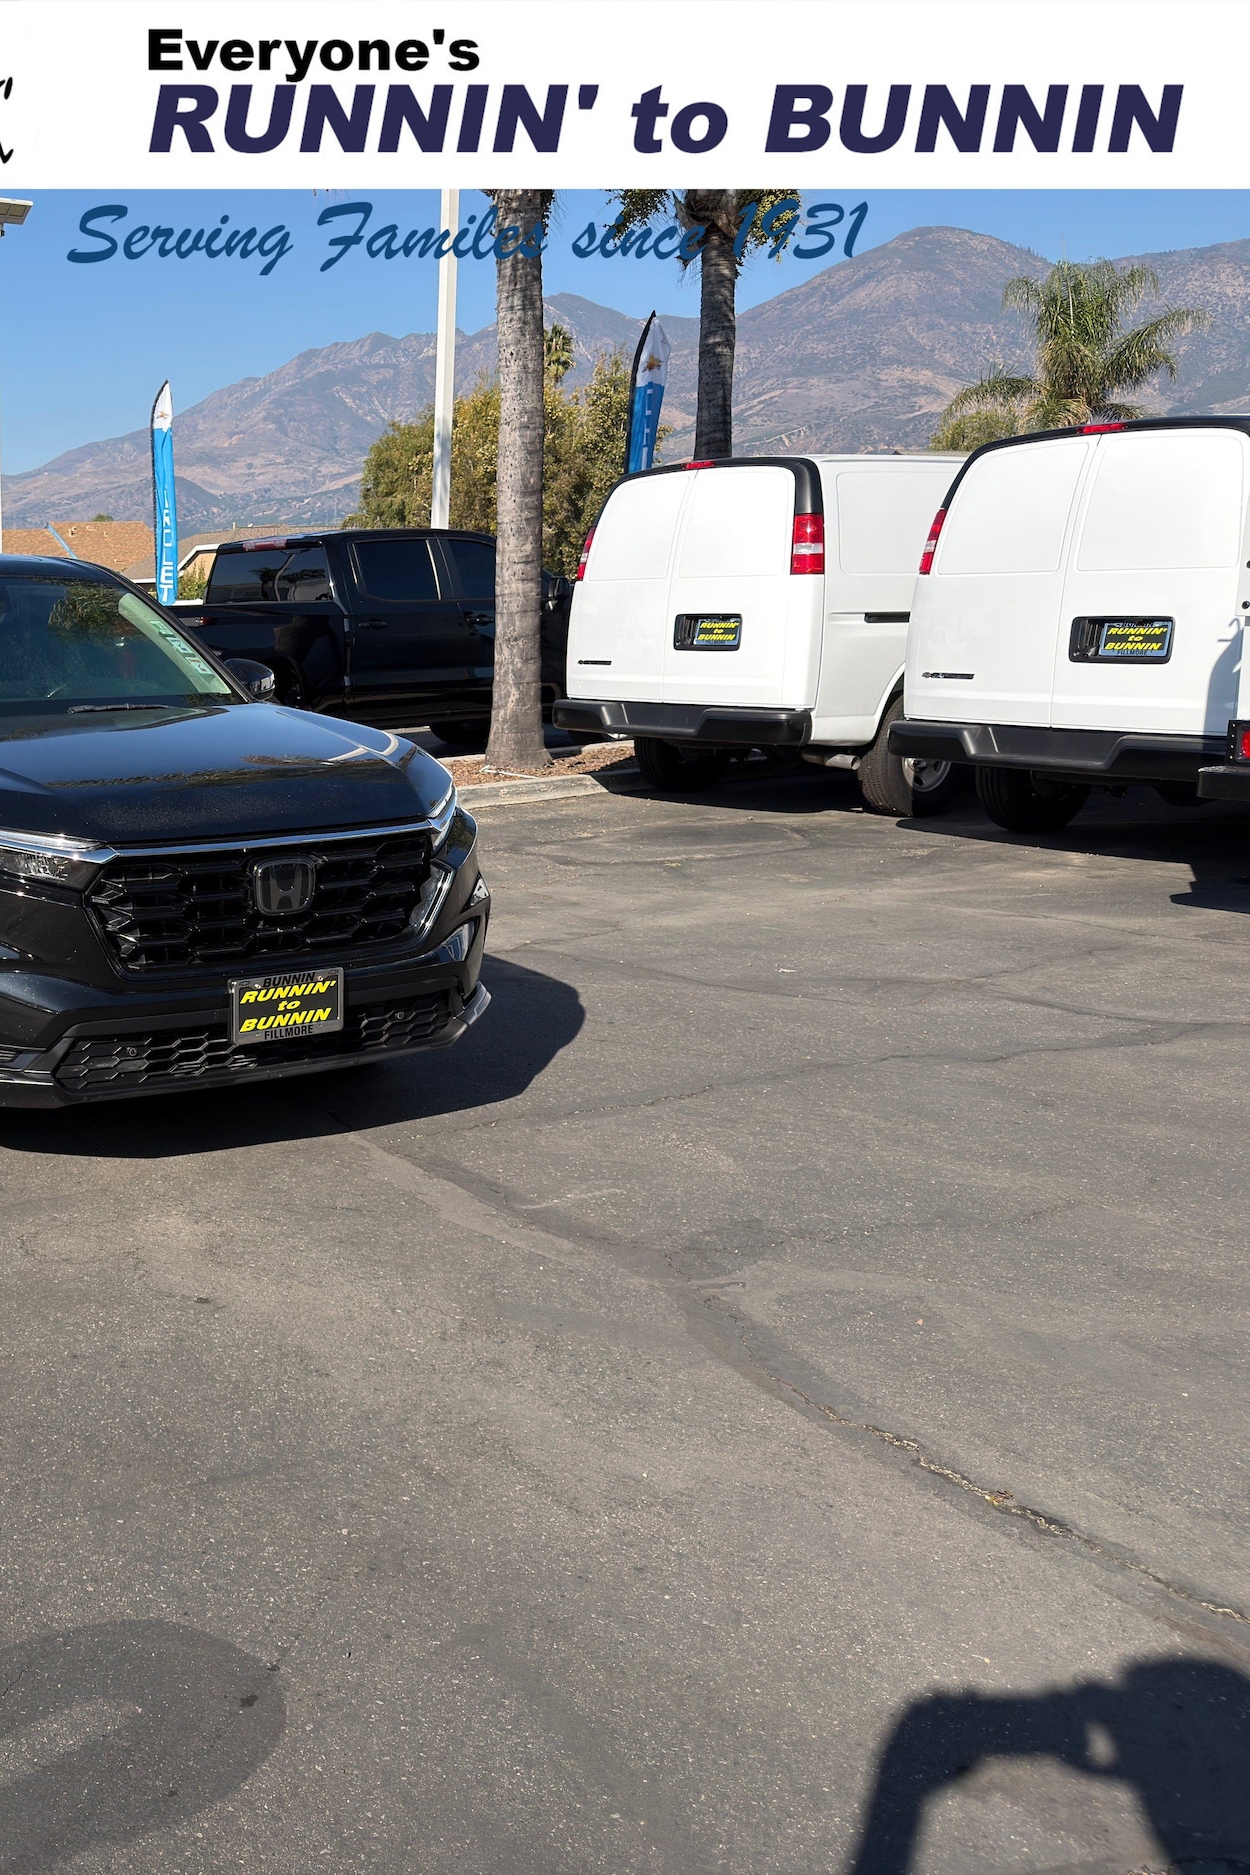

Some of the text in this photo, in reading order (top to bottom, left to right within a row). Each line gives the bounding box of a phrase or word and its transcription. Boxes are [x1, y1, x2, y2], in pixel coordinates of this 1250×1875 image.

[1107, 627, 1168, 635] RUNNIN'
[1104, 642, 1162, 650] BUNNIN
[263, 972, 316, 988] BUNNIN
[239, 980, 337, 1004] RUNNIN'
[277, 1000, 301, 1011] to
[239, 1007, 332, 1033] BUNNIN
[264, 1024, 314, 1040] FILLMORE
